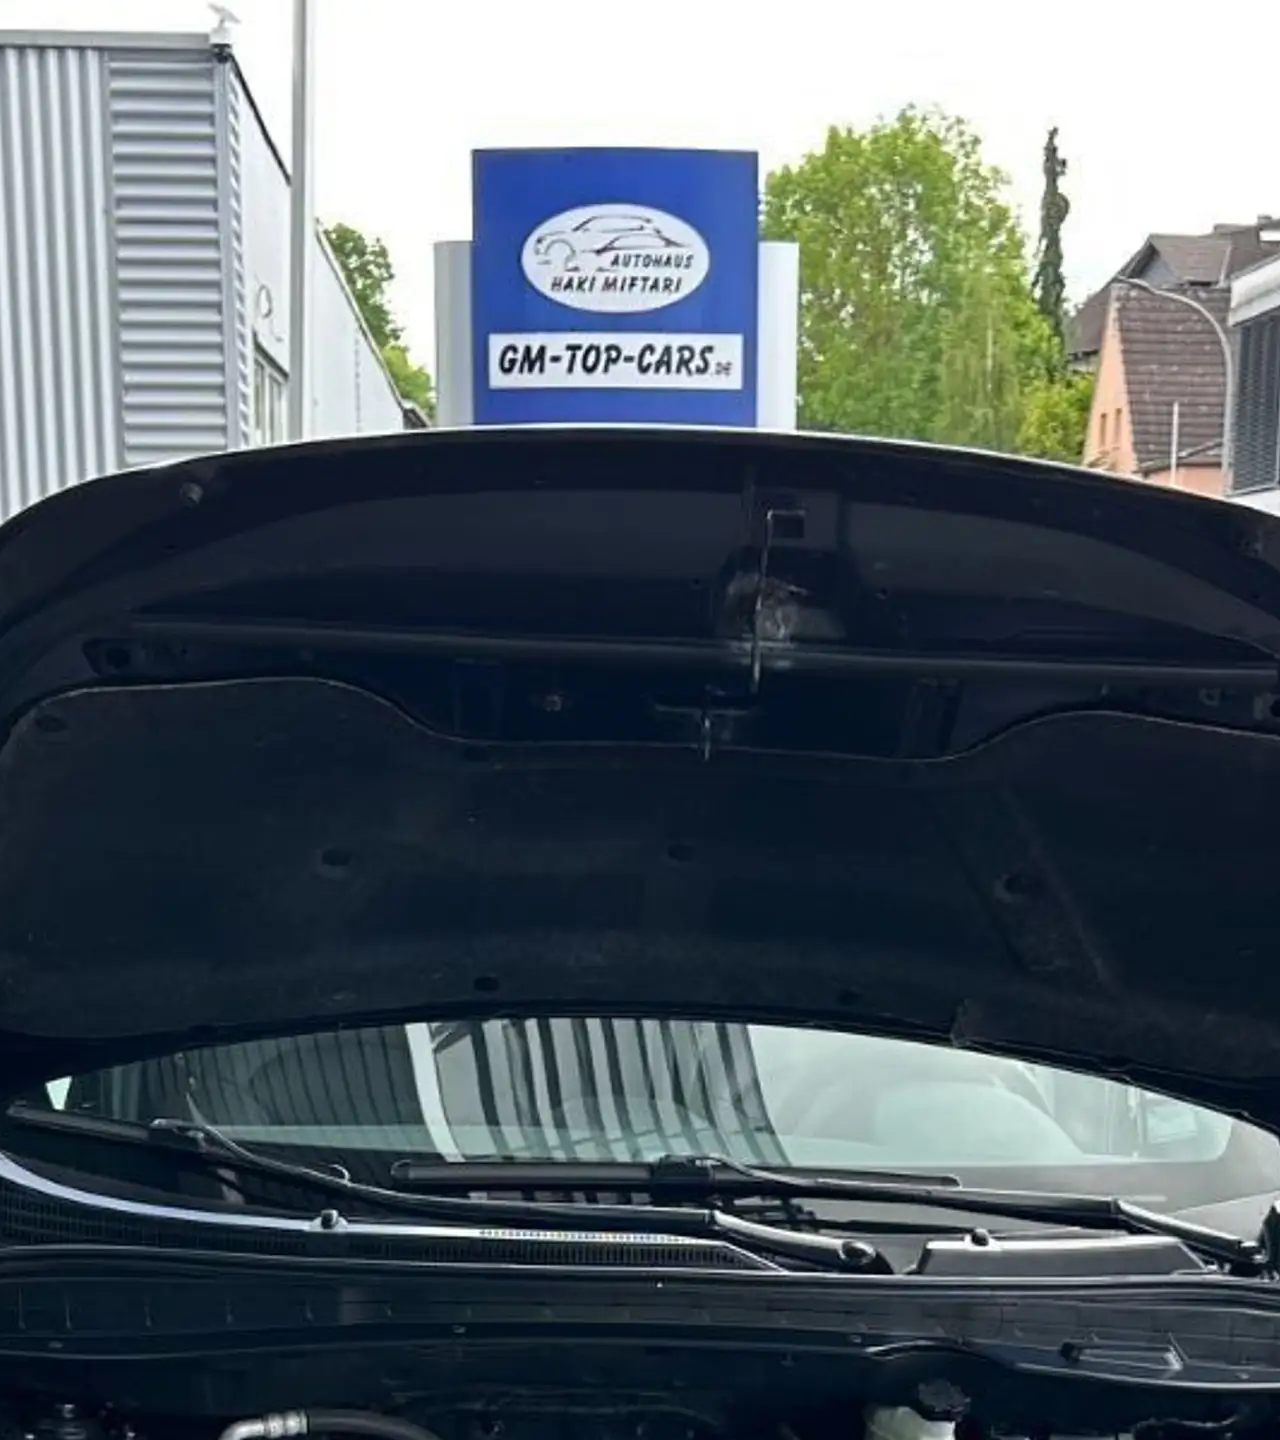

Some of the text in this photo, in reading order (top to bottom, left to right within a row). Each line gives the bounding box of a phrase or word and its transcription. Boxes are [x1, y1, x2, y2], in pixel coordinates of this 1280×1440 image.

[609, 253, 694, 270] AUTOHAUS
[550, 275, 683, 295] HAKI MIFTARI
